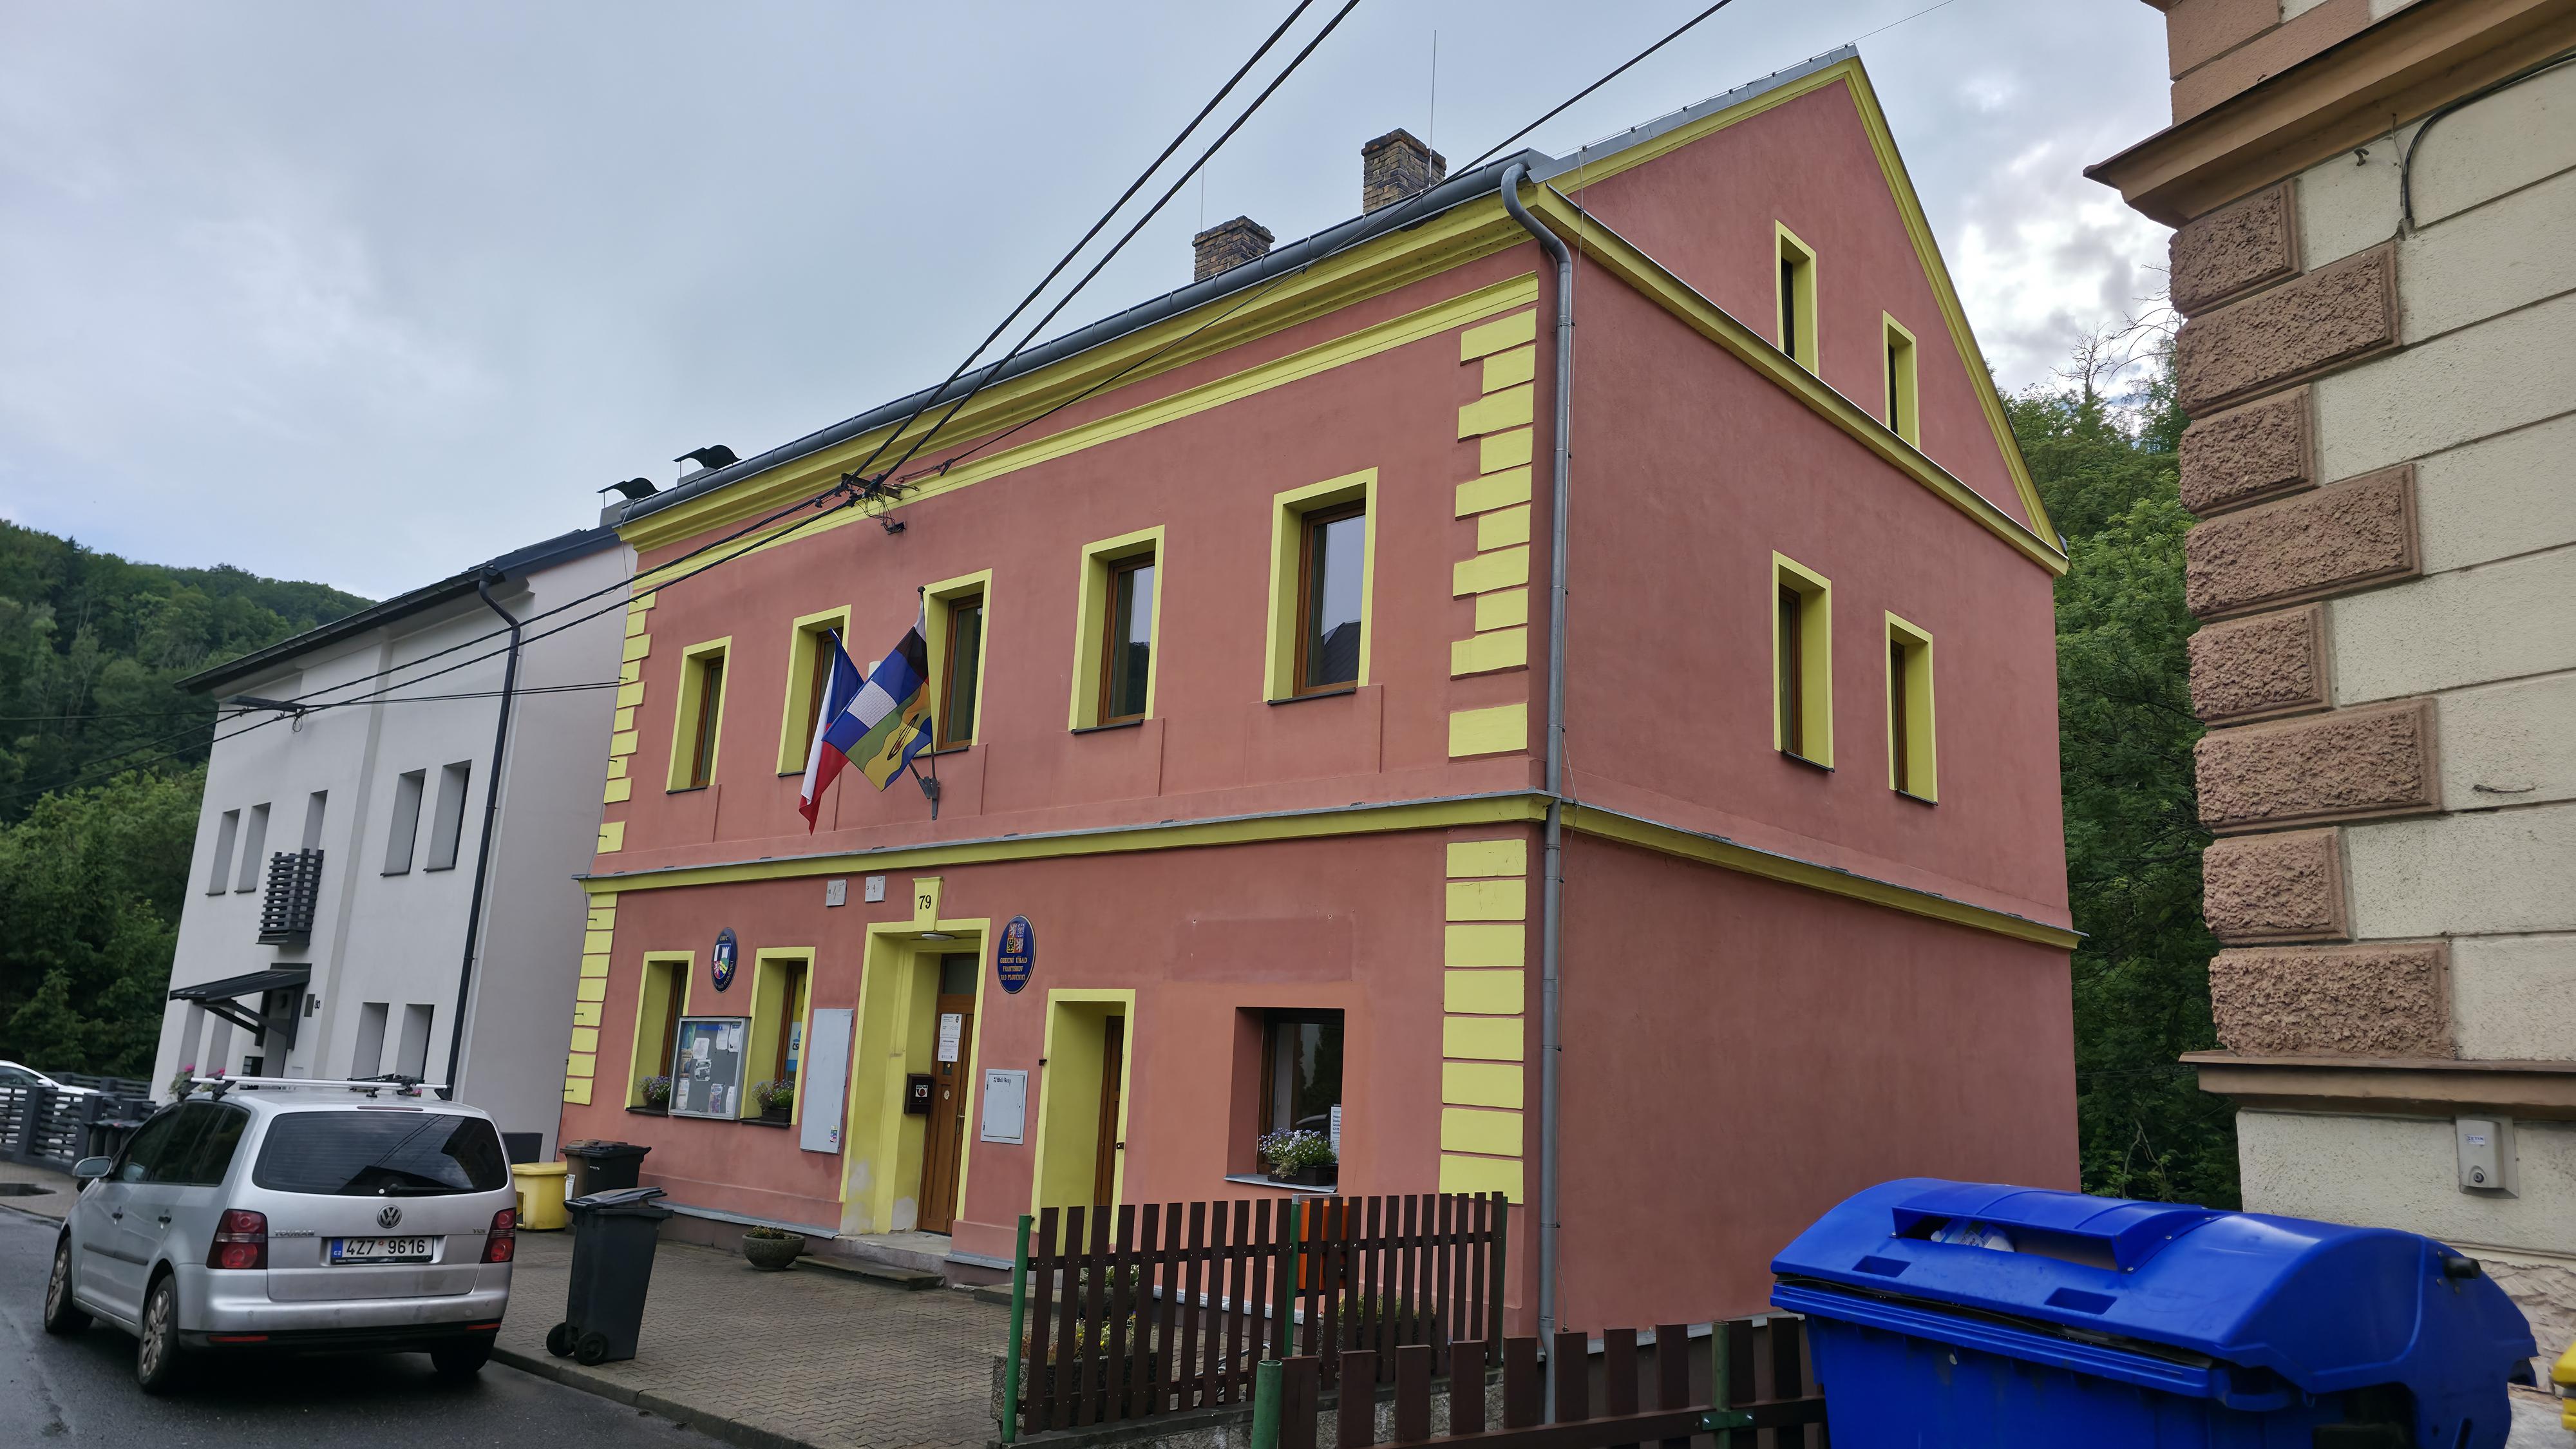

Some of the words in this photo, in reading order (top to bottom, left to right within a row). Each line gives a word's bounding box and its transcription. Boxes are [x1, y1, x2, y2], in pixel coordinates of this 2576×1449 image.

[919, 895, 932, 910] 79
[346, 1240, 375, 1255] 4Z7
[388, 1238, 426, 1255] 9616
